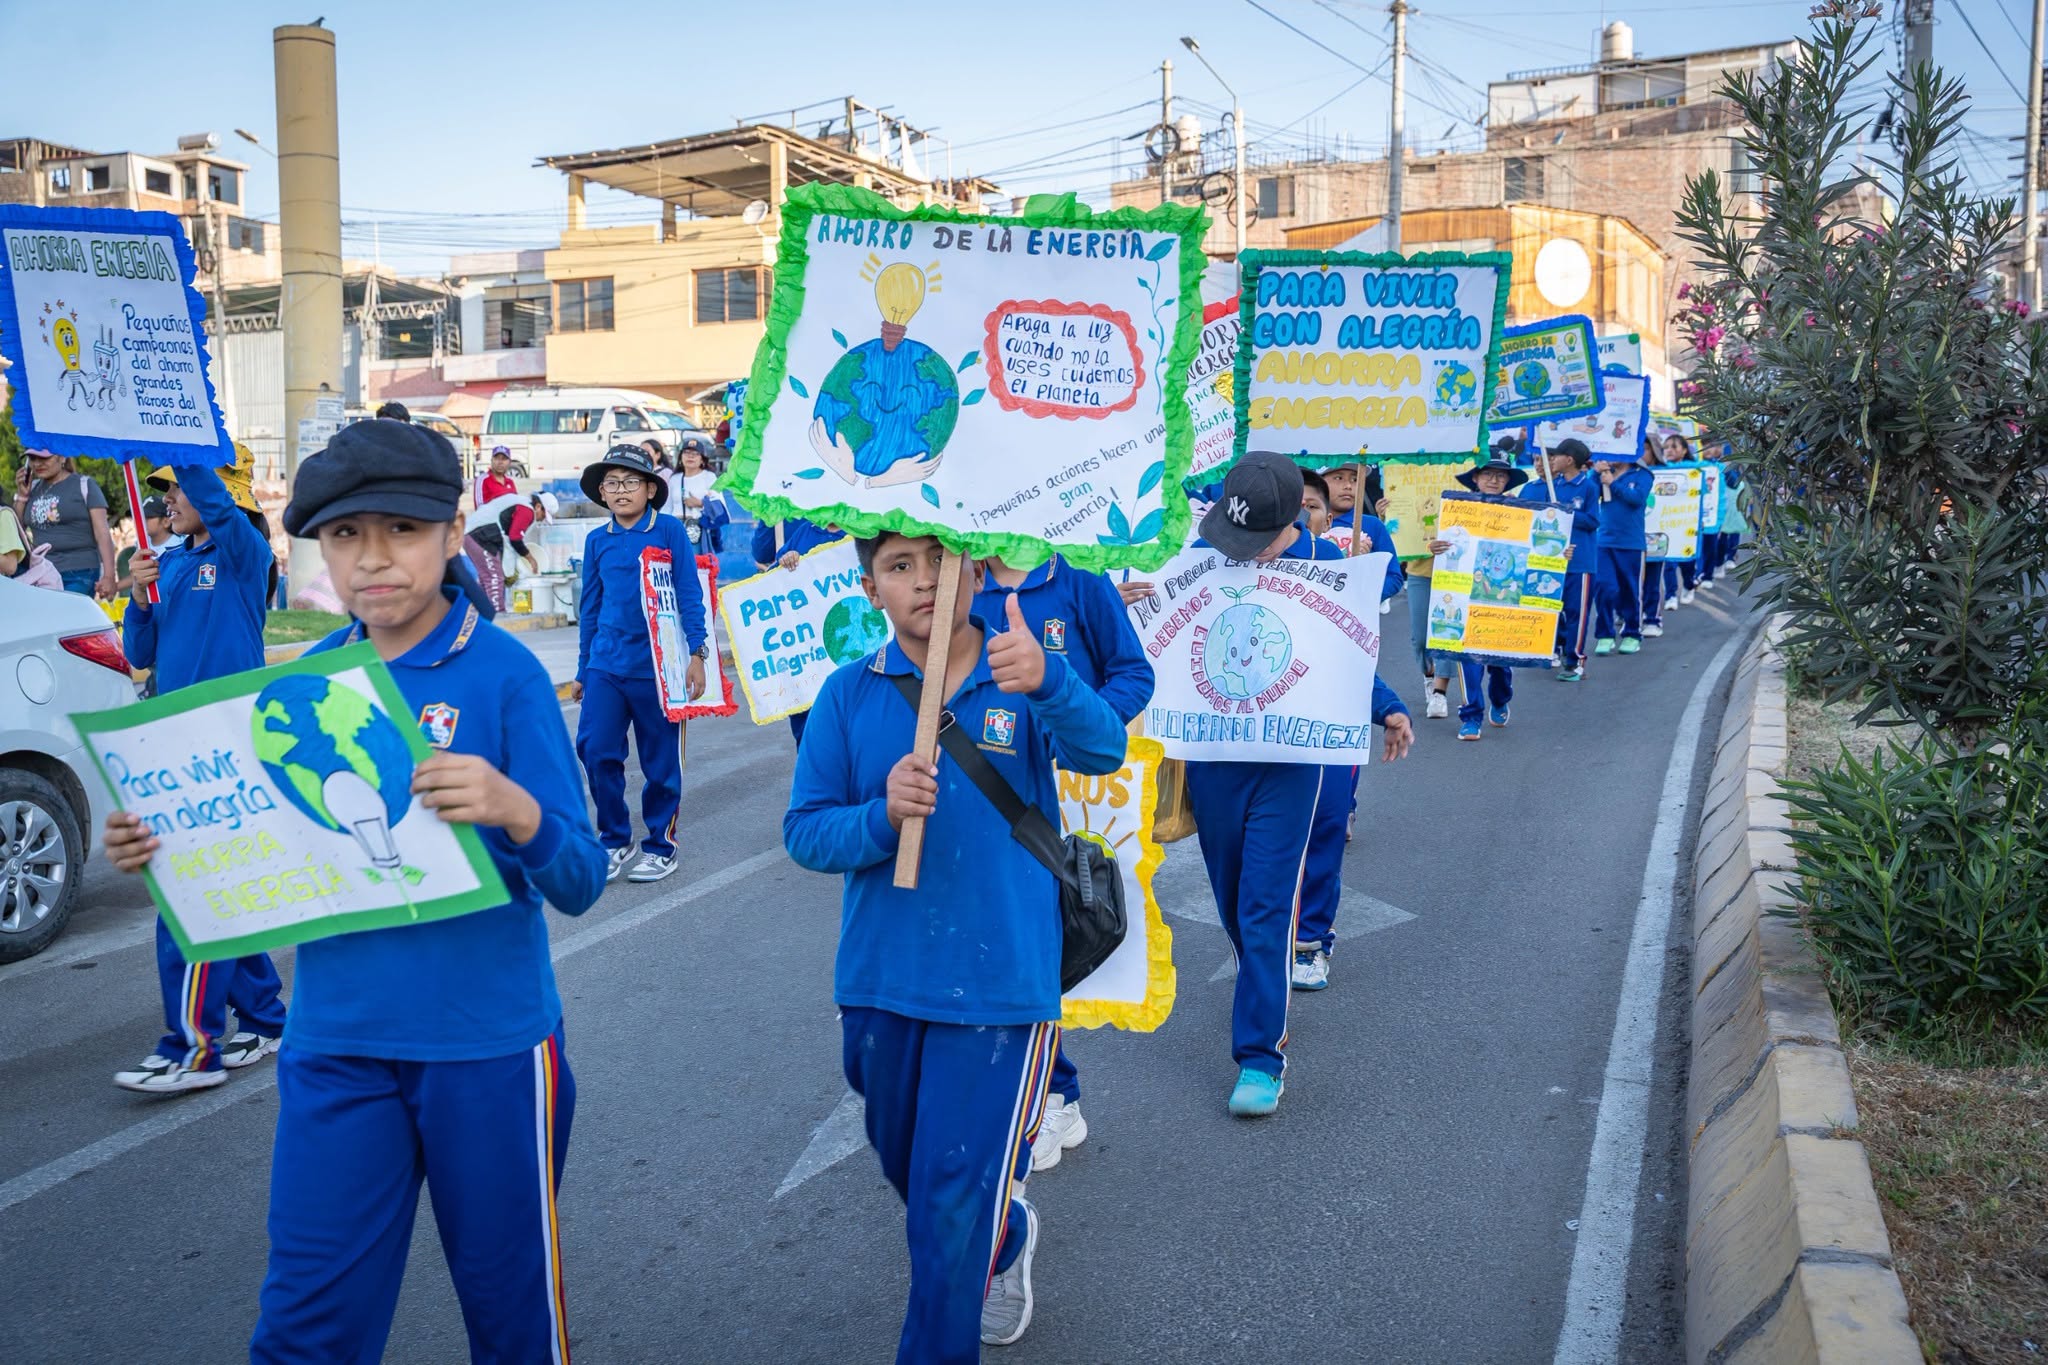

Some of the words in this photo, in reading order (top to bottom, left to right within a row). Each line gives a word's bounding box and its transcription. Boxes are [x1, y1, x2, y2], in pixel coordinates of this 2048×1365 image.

[817, 214, 913, 250] AHORRO
[933, 226, 973, 251] DE
[10, 236, 87, 273] AHORRA
[1257, 271, 1346, 308] PARA
[1362, 272, 1458, 309] VIVIR
[121, 303, 191, 339] Pequeños
[1061, 321, 1076, 338] la
[1253, 311, 1322, 349] CON
[1337, 308, 1481, 350] ALEGRÍA
[1006, 337, 1063, 360] cuando
[1071, 350, 1089, 365] no
[1095, 348, 1109, 366] la
[1541, 335, 1553, 346] DE
[131, 354, 151, 371] del
[158, 357, 194, 373] ahorro
[1007, 357, 1051, 377] uses
[1062, 366, 1134, 385] cuidemos
[1256, 351, 1421, 387] AHORRA
[133, 375, 183, 394] grandes
[179, 393, 196, 410] del
[1011, 378, 1027, 393] el
[139, 411, 203, 428] mañana
[1046, 457, 1101, 489] acciones
[1100, 439, 1138, 461] hacen
[1145, 423, 1166, 445] una
[1193, 427, 1235, 457] ROVECHA
[1207, 445, 1230, 463] LUZ
[1059, 481, 1093, 508] gran
[739, 588, 808, 627] Para
[1133, 589, 1161, 629] NO
[1164, 555, 1217, 600] PORQUE
[1147, 586, 1213, 658] DEBEMOS
[1256, 575, 1380, 658] DESPERDICIARLA
[752, 646, 827, 681] alegría
[1190, 624, 1233, 715] CUIDEMOS
[1236, 698, 1254, 714] AL
[1256, 659, 1309, 711] MUNDO
[1263, 714, 1371, 750] ENERGIA
[105, 752, 182, 803] Para
[182, 750, 239, 784] vivir
[176, 779, 277, 830] alegría
[170, 830, 287, 881] AHORRA
[203, 852, 353, 919] ENERGÍA
